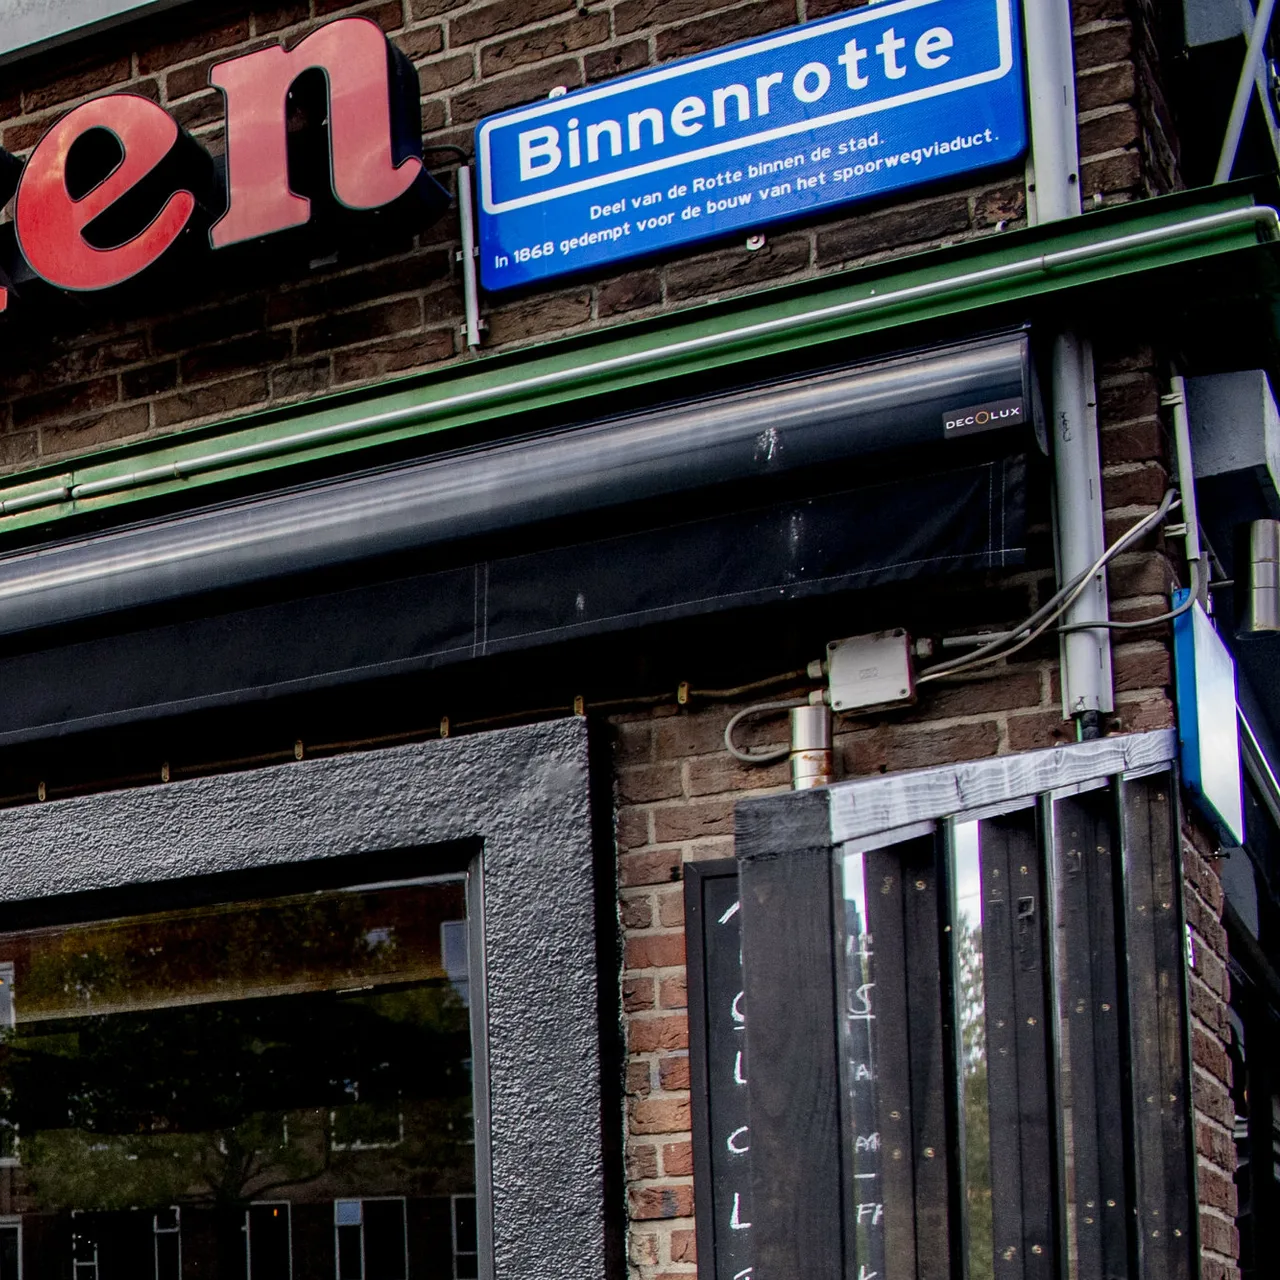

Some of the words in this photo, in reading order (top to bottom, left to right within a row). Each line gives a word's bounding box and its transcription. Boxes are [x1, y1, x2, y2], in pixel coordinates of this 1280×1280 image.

[518, 24, 955, 182] Binnenrotte
[495, 254, 508, 269] In
[513, 241, 554, 264] 1868
[559, 221, 631, 255] gedempt
[636, 212, 675, 232] voor
[681, 204, 701, 221] de
[706, 191, 752, 215] bouw
[759, 182, 791, 201] van
[796, 171, 827, 192] het
[832, 127, 1000, 183] spoorwegviaduct.
[590, 199, 626, 220] Deel
[631, 190, 662, 209] van
[667, 183, 687, 201] de
[692, 169, 742, 194] Rotte
[748, 153, 805, 179] binnen
[810, 145, 832, 163] de
[838, 131, 885, 156] stad.
[945, 406, 1021, 430] DECOLUX
